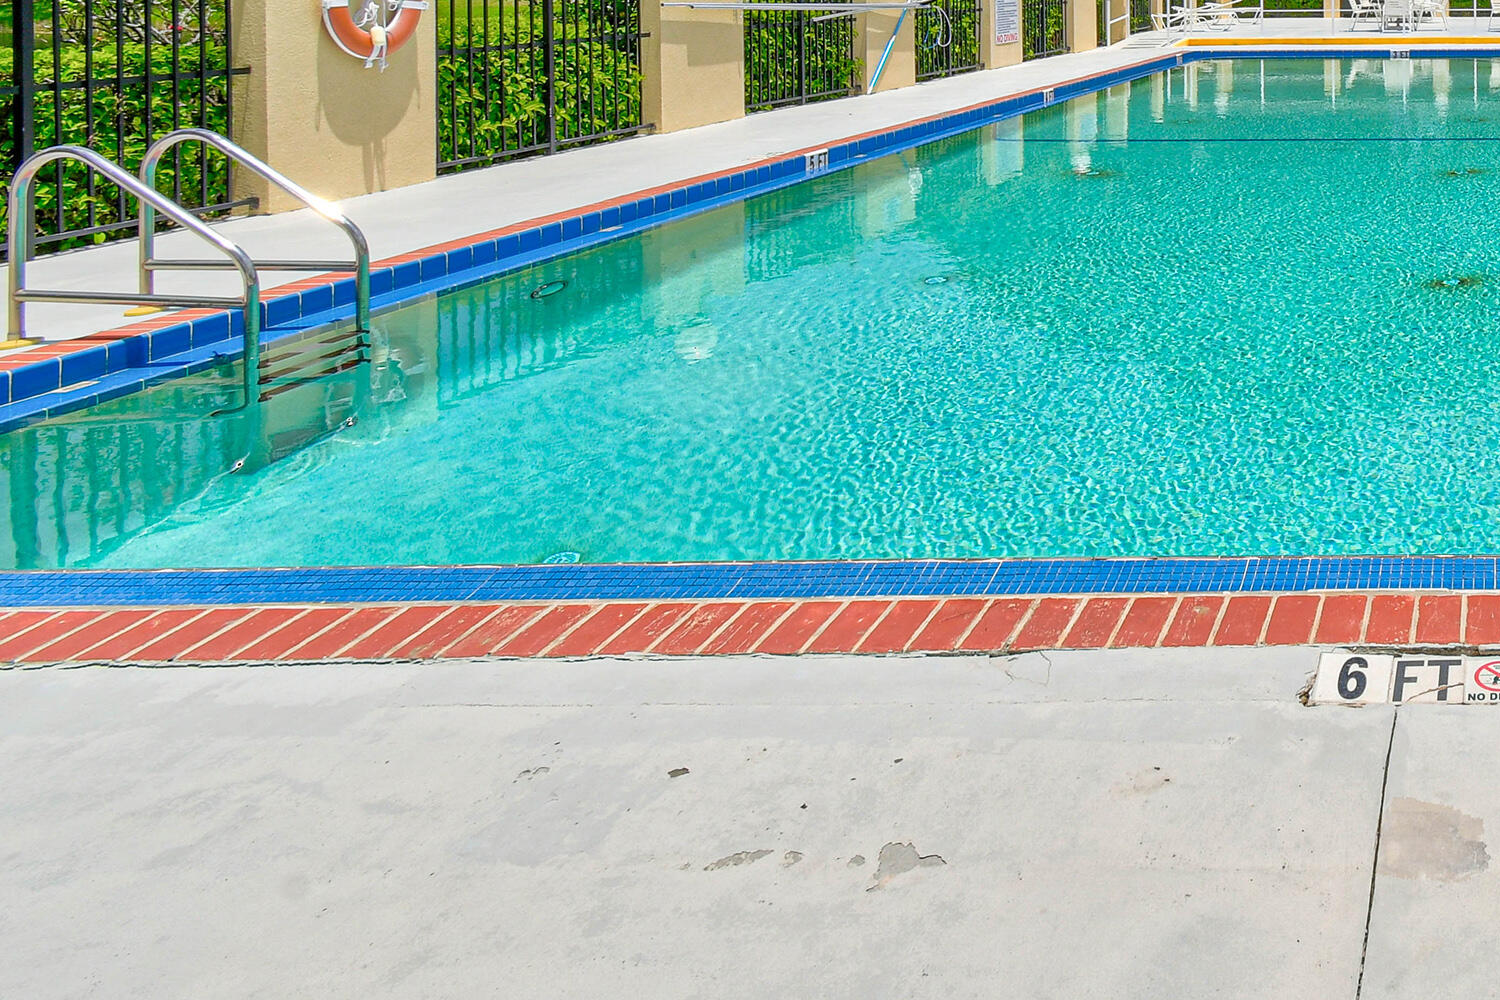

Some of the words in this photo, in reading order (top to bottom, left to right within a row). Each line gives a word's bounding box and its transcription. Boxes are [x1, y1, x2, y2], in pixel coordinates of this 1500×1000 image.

[997, 34, 1003, 43] NO
[1004, 32, 1018, 42] DIVING
[817, 151, 827, 169] FT
[1337, 656, 1369, 700] 6
[1392, 659, 1462, 702] FT
[1467, 692, 1486, 701] NO
